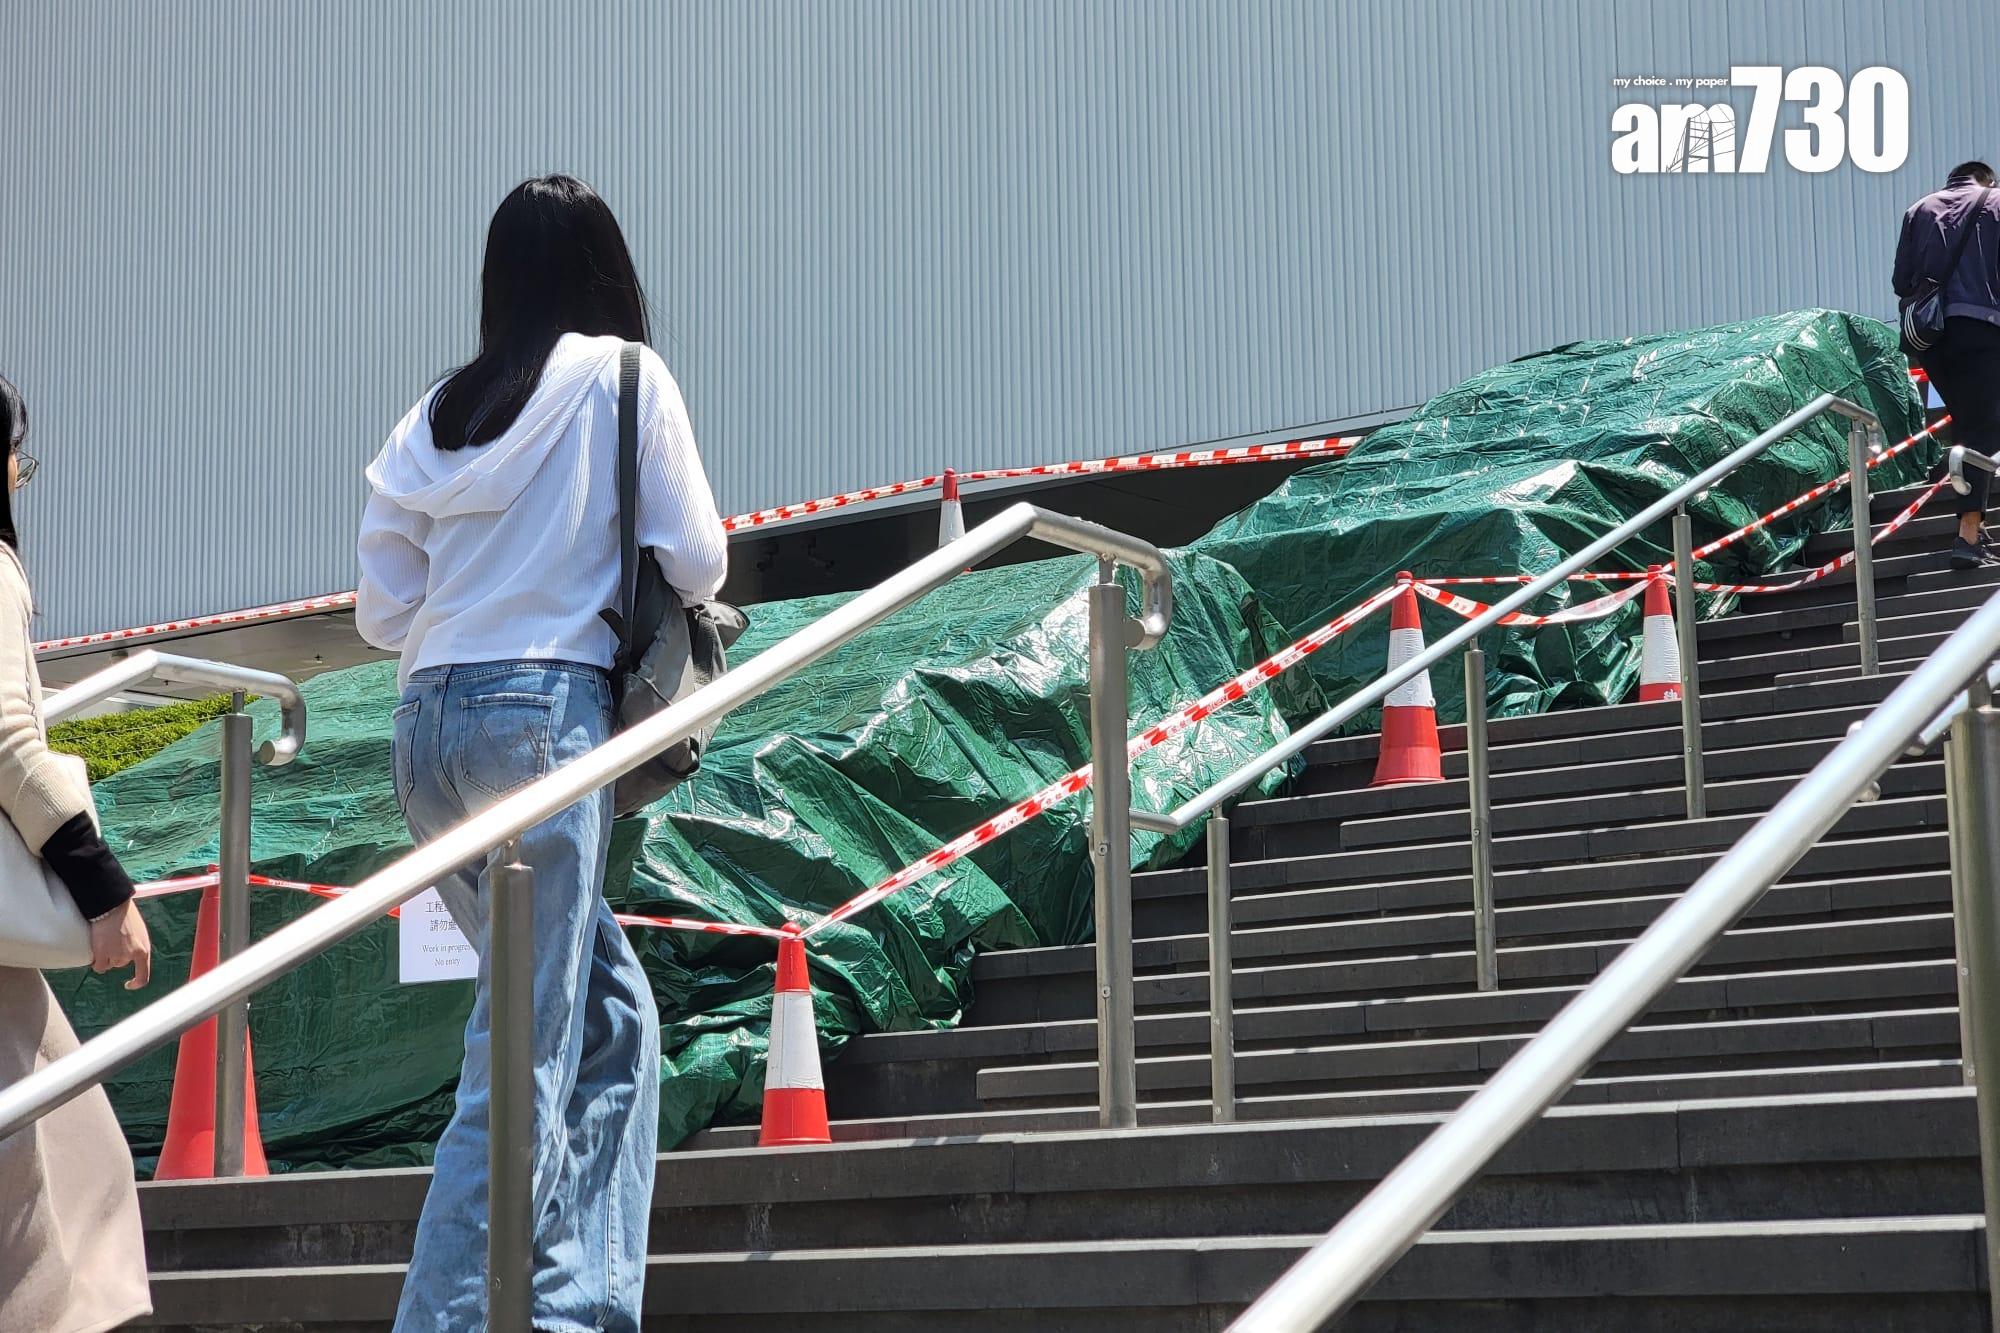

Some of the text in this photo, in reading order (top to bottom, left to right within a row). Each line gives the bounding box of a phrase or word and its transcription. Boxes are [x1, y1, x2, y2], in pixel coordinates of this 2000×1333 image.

[425, 901, 448, 912] 工程
[422, 944, 440, 953] Work
[434, 957, 460, 967] No entry
